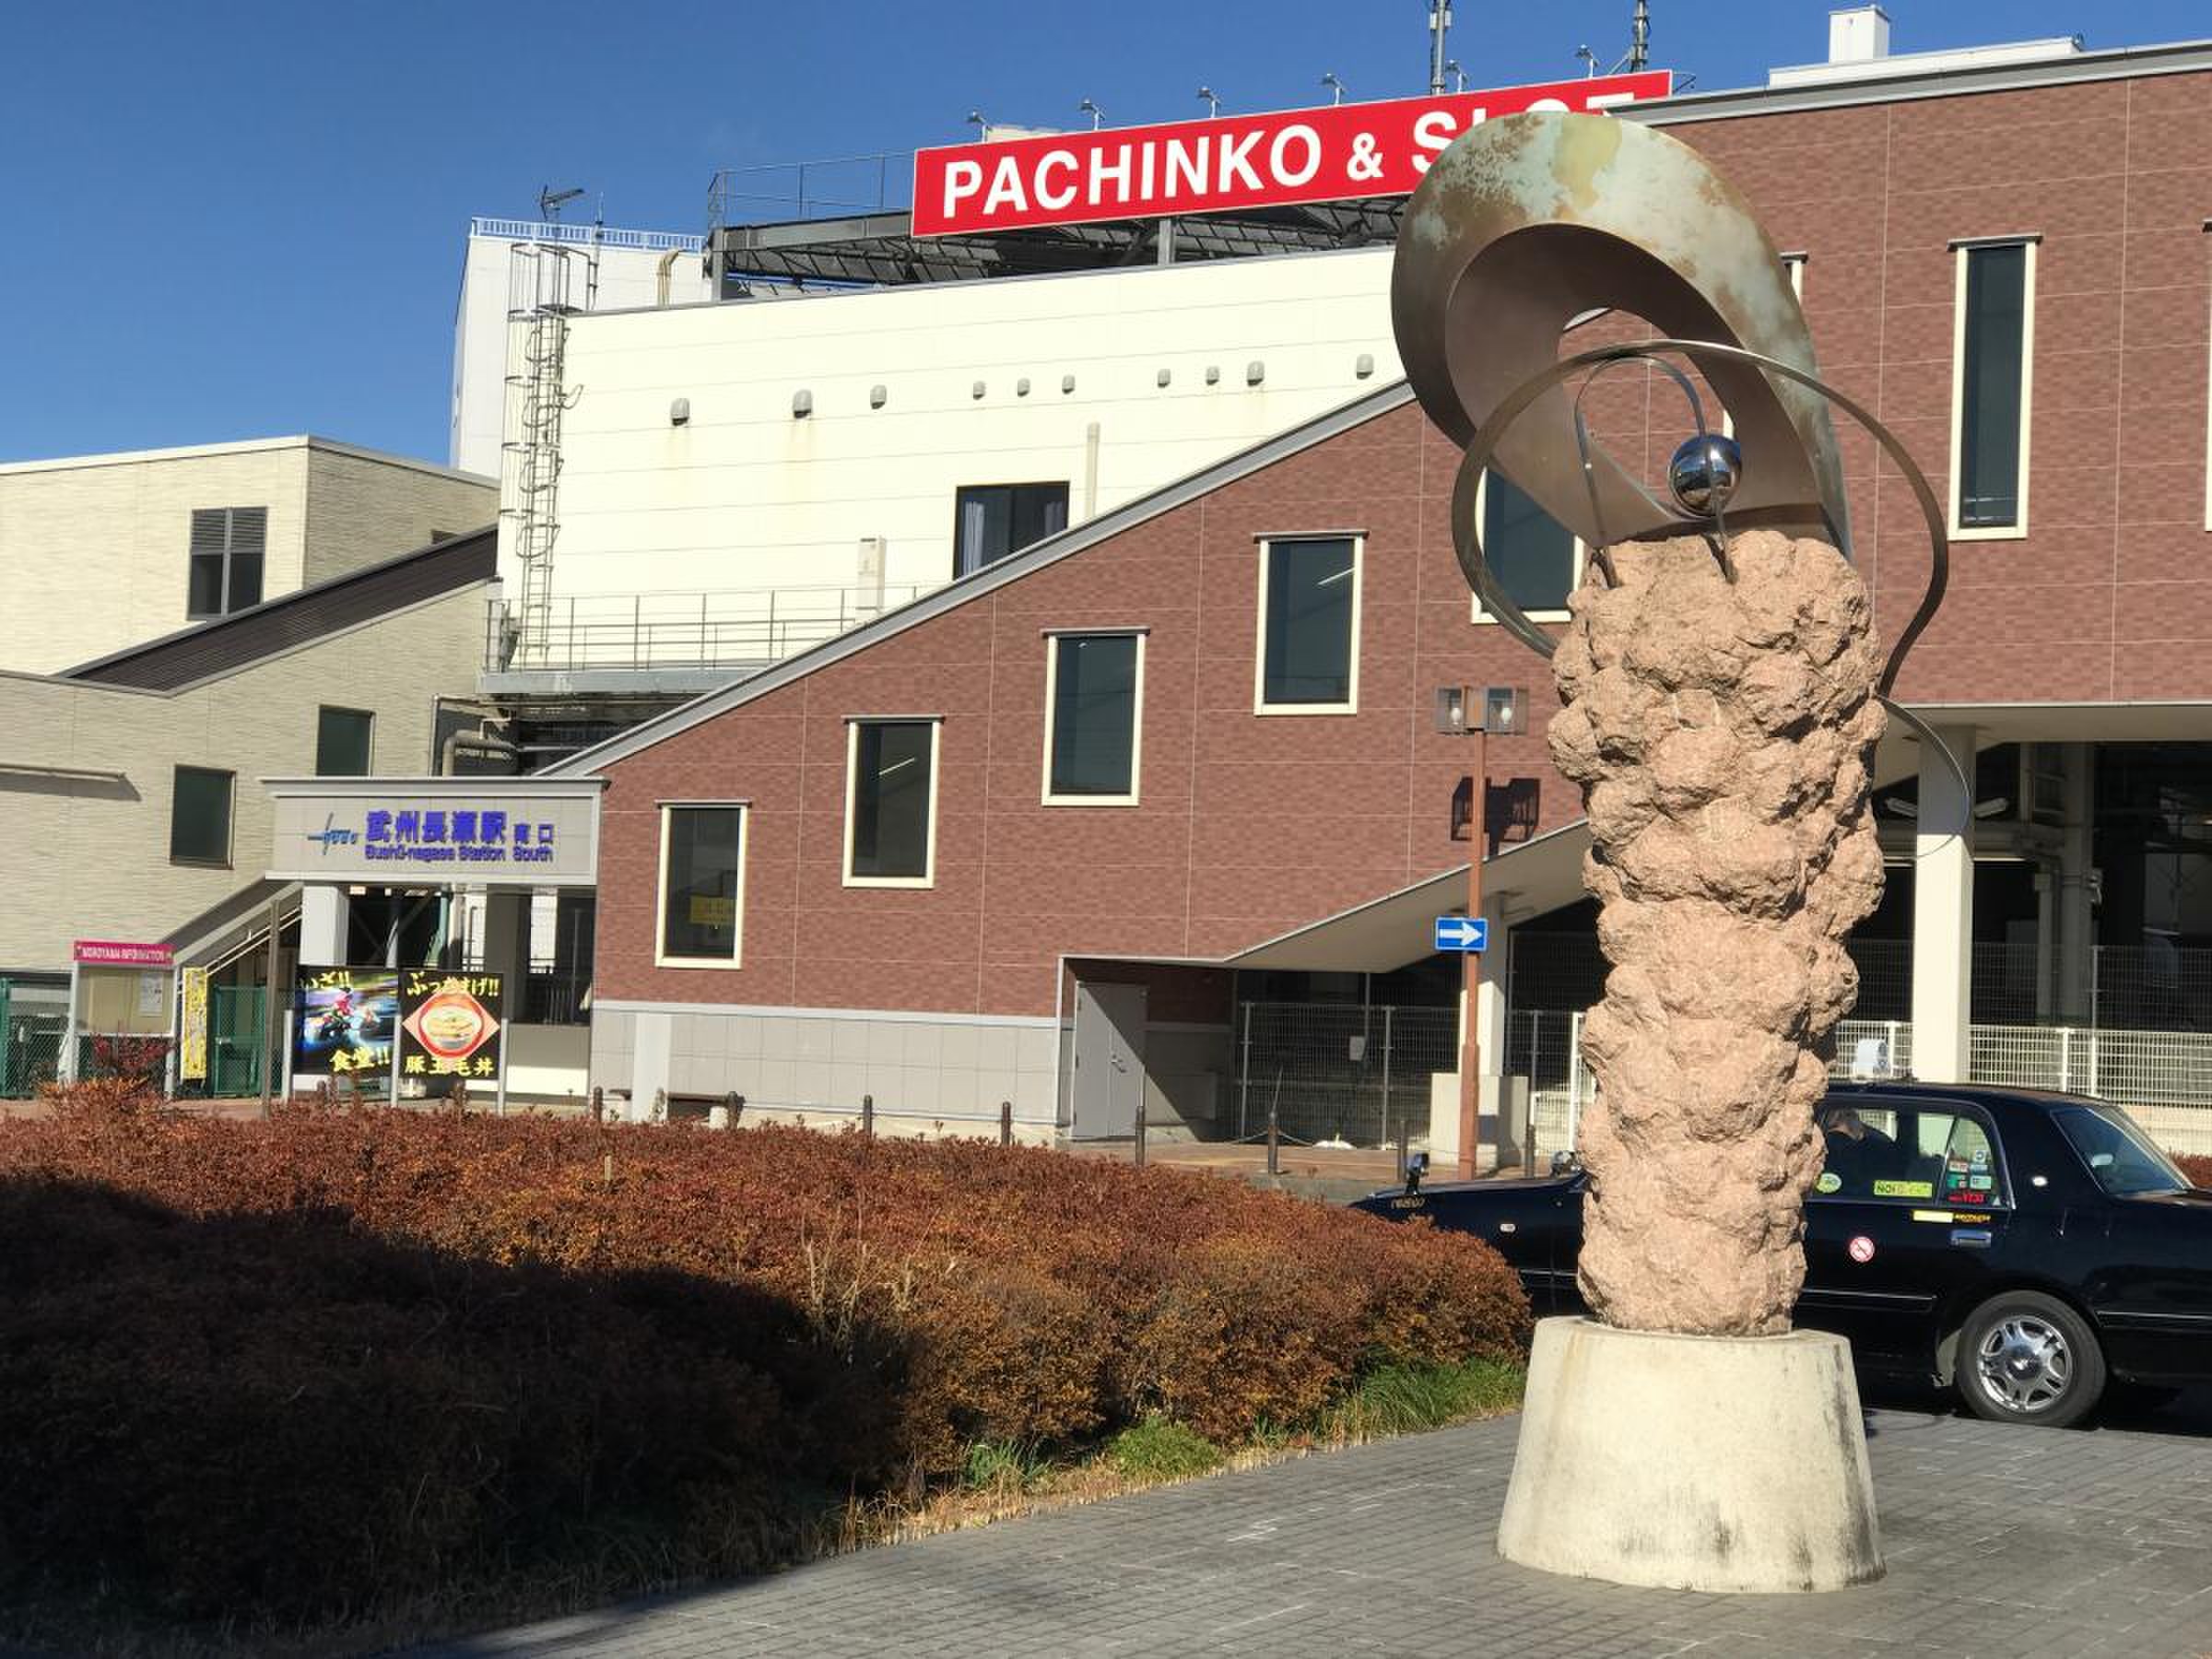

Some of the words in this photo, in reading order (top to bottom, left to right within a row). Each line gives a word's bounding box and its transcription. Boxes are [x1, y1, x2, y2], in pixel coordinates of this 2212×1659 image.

[943, 124, 1322, 218] PACHINKO
[1347, 132, 1384, 181] &
[459, 845, 506, 862] Station
[512, 845, 554, 863] South
